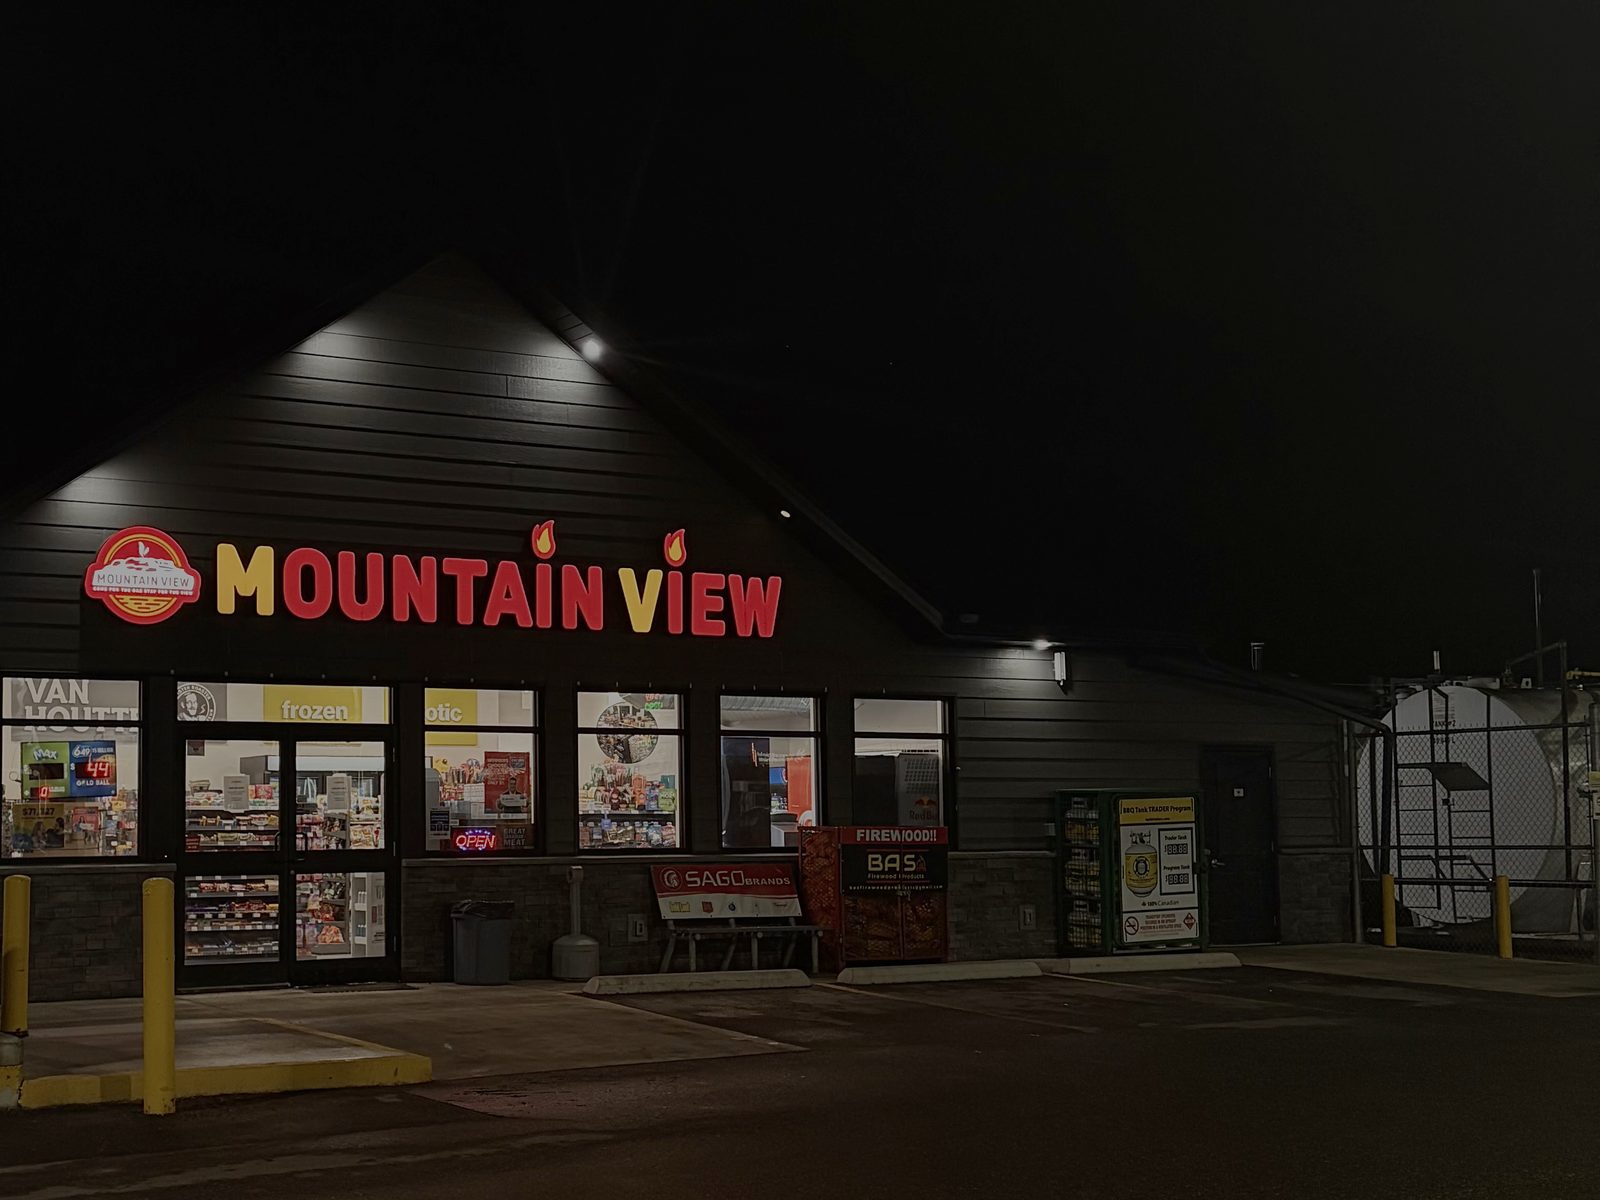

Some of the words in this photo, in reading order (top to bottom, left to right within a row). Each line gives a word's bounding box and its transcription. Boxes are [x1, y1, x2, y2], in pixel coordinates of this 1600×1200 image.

[97, 574, 158, 586] MOUNTAIN
[161, 577, 190, 587] VIEW
[217, 520, 604, 630] MOUNTAIN
[618, 528, 782, 638] VIEW
[25, 679, 89, 705] VAN
[281, 700, 348, 720] frozen
[426, 703, 464, 722] otic
[455, 834, 496, 848] OPEN
[867, 854, 917, 872] BAS
[685, 870, 745, 887] SAGO
[745, 876, 791, 886] BRANDS
